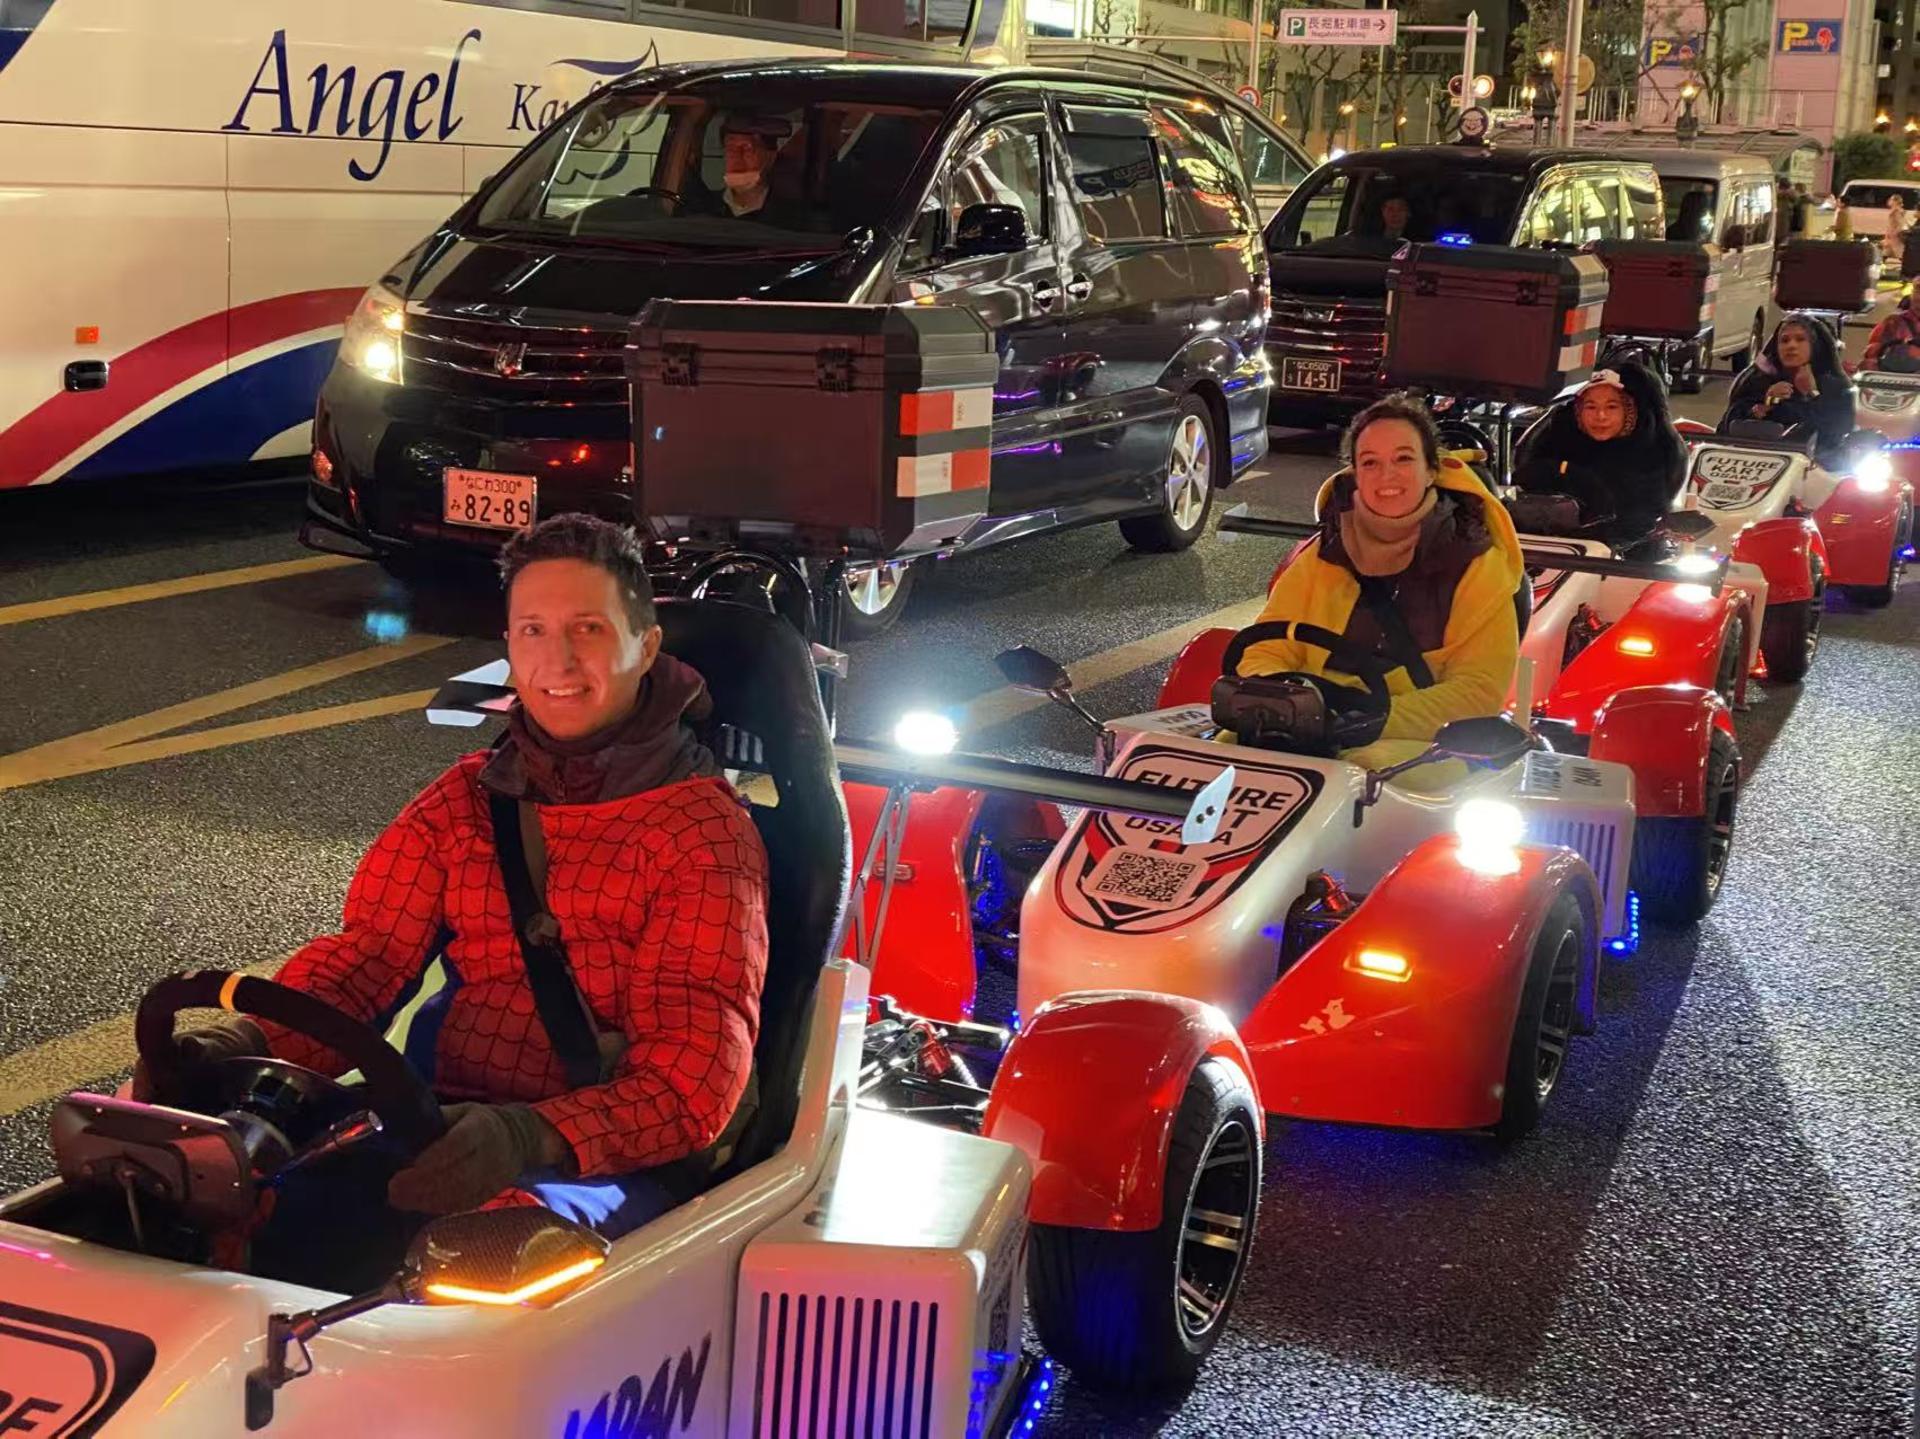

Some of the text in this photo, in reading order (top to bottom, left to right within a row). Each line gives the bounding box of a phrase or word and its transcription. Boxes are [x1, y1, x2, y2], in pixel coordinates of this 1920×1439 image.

[1290, 18, 1303, 35] P
[221, 28, 482, 182] Angel
[1297, 370, 1335, 389] 14-51
[1706, 456, 1781, 470] FUTURE
[1711, 465, 1768, 476] KART
[1709, 472, 1761, 481] OSAKA
[465, 493, 530, 526] 82-89
[1124, 815, 1234, 846] OSAA
